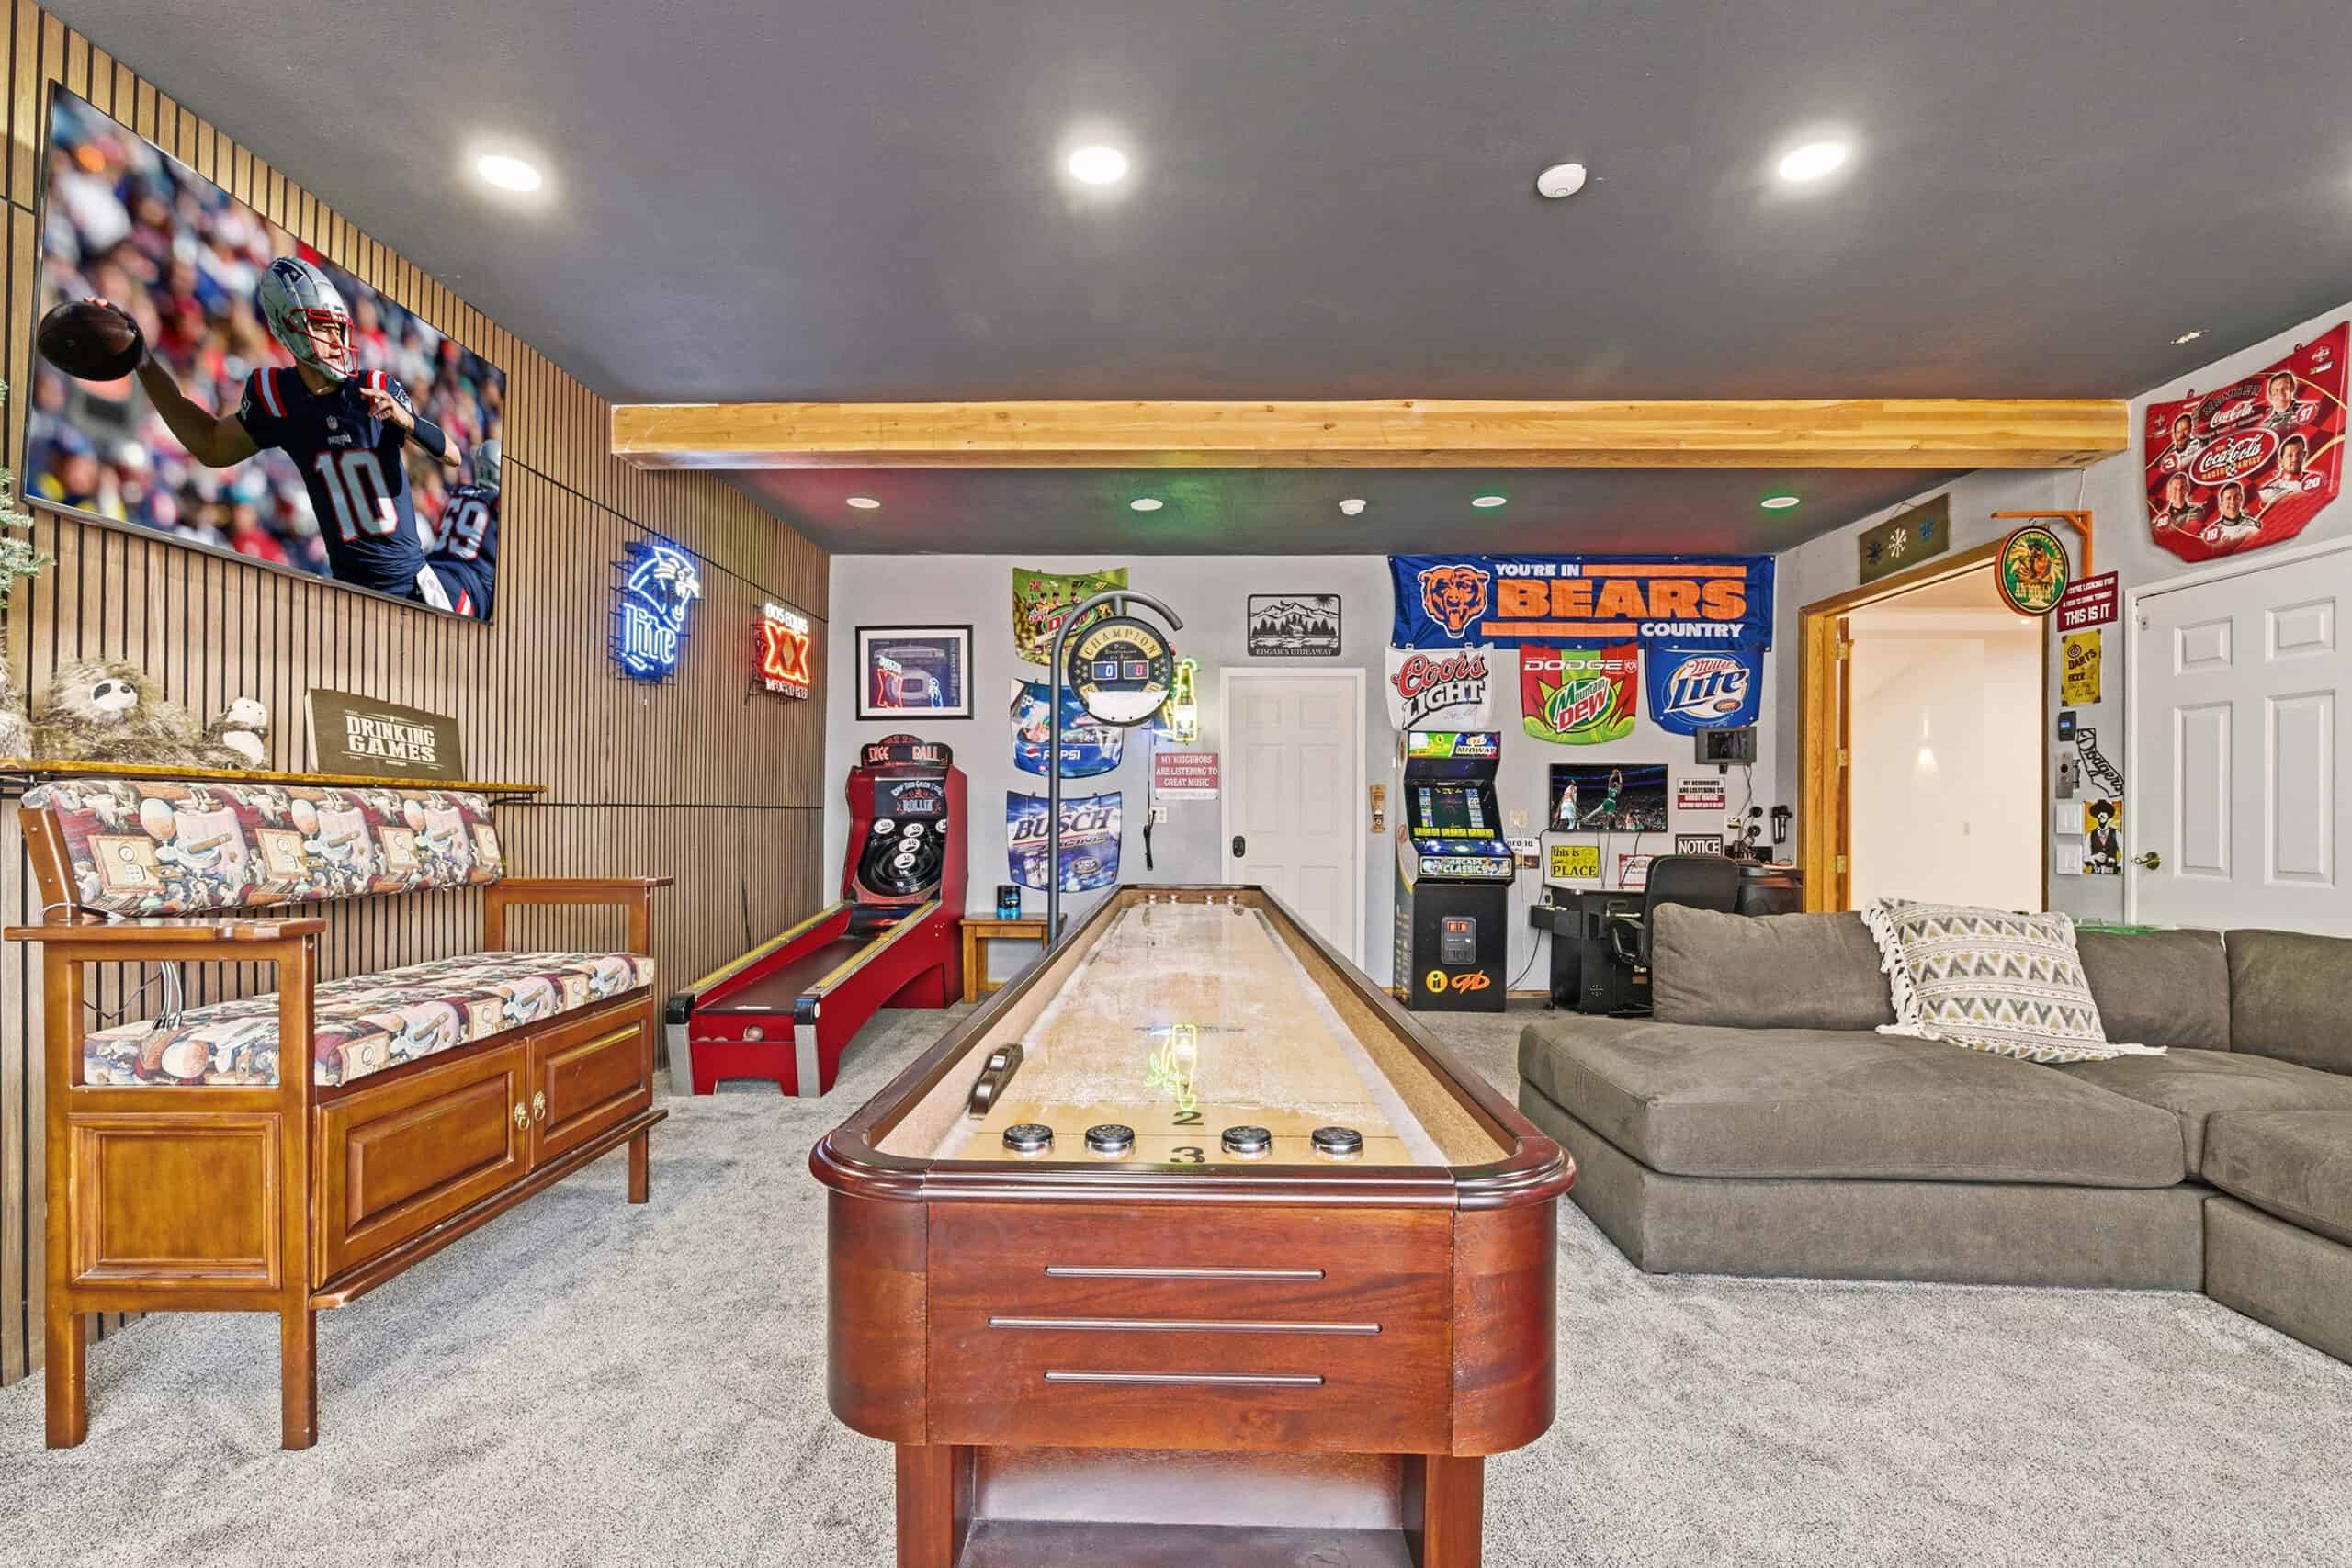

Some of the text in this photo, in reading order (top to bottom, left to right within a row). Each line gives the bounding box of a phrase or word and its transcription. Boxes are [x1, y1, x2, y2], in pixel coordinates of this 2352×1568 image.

[315, 447, 398, 542] 10
[1496, 564, 1579, 577] YOU'RE IN
[1498, 580, 1747, 620] BEARS
[2064, 603, 2111, 626] THIS IS IT
[1641, 623, 1744, 637] COUNTRY
[764, 620, 809, 684] XX
[1085, 628, 1158, 656] CHAMPION
[1524, 660, 1623, 671] DODGE
[1687, 658, 1733, 677] Miller
[2068, 649, 2097, 670] DARTS
[1105, 664, 1114, 677] 0
[1136, 664, 1144, 677] 0
[1390, 653, 1488, 699] Coors
[1665, 669, 1749, 713] Lite
[1403, 680, 1485, 730] LIGHT
[345, 716, 435, 747] DRINKING
[349, 735, 436, 763] GAMES
[1043, 750, 1080, 761] PPSI
[2077, 728, 2123, 792] Dodgers
[1012, 808, 1113, 840] BUSCH
[1553, 845, 1580, 857] this is
[1679, 840, 1720, 854] NOTICE
[1553, 866, 1597, 876] PLACE
[1172, 1111, 1204, 1126] 2
[1170, 1145, 1205, 1163] 3
